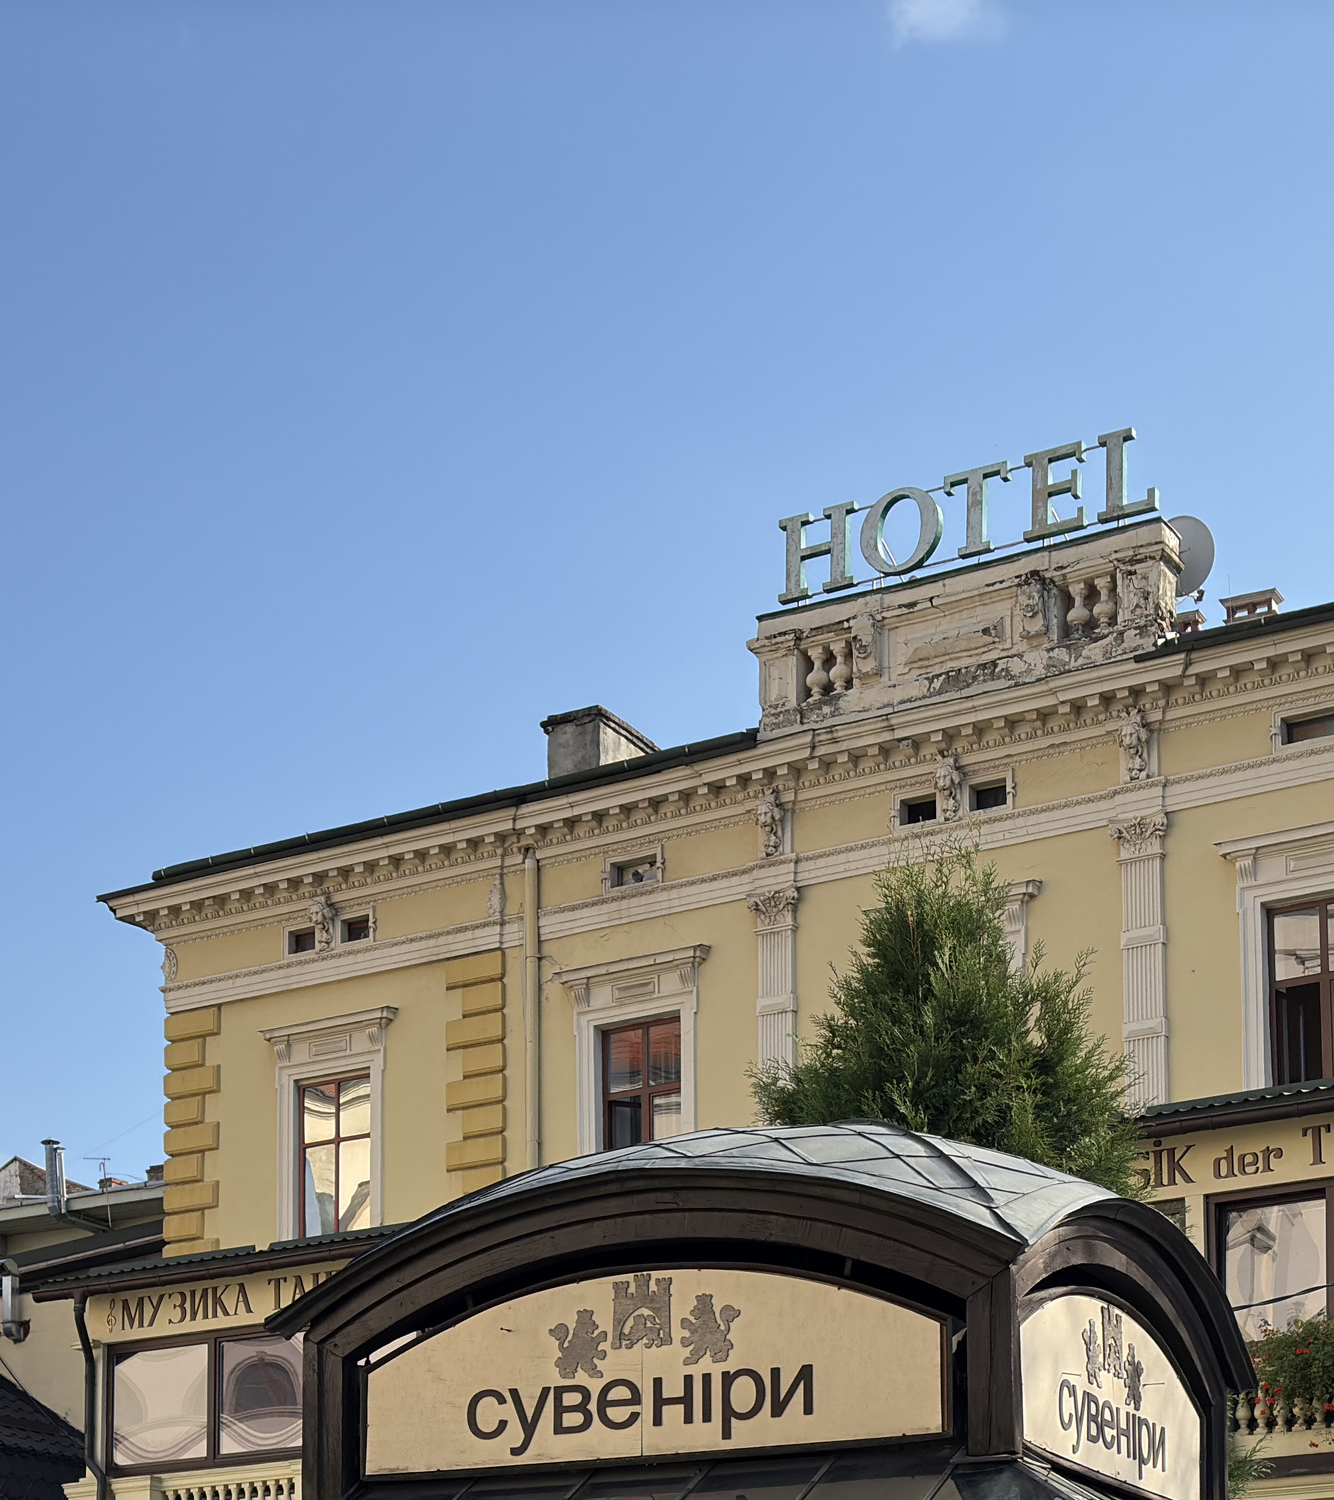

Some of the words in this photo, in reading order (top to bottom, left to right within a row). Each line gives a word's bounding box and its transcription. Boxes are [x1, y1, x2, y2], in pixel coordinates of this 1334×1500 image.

[778, 427, 1160, 605] HOTEL
[1213, 1144, 1284, 1180] der
[120, 1282, 254, 1331] МУЗИКА
[466, 1363, 814, 1457] сувеніри
[1058, 1378, 1166, 1481] сувеніри
